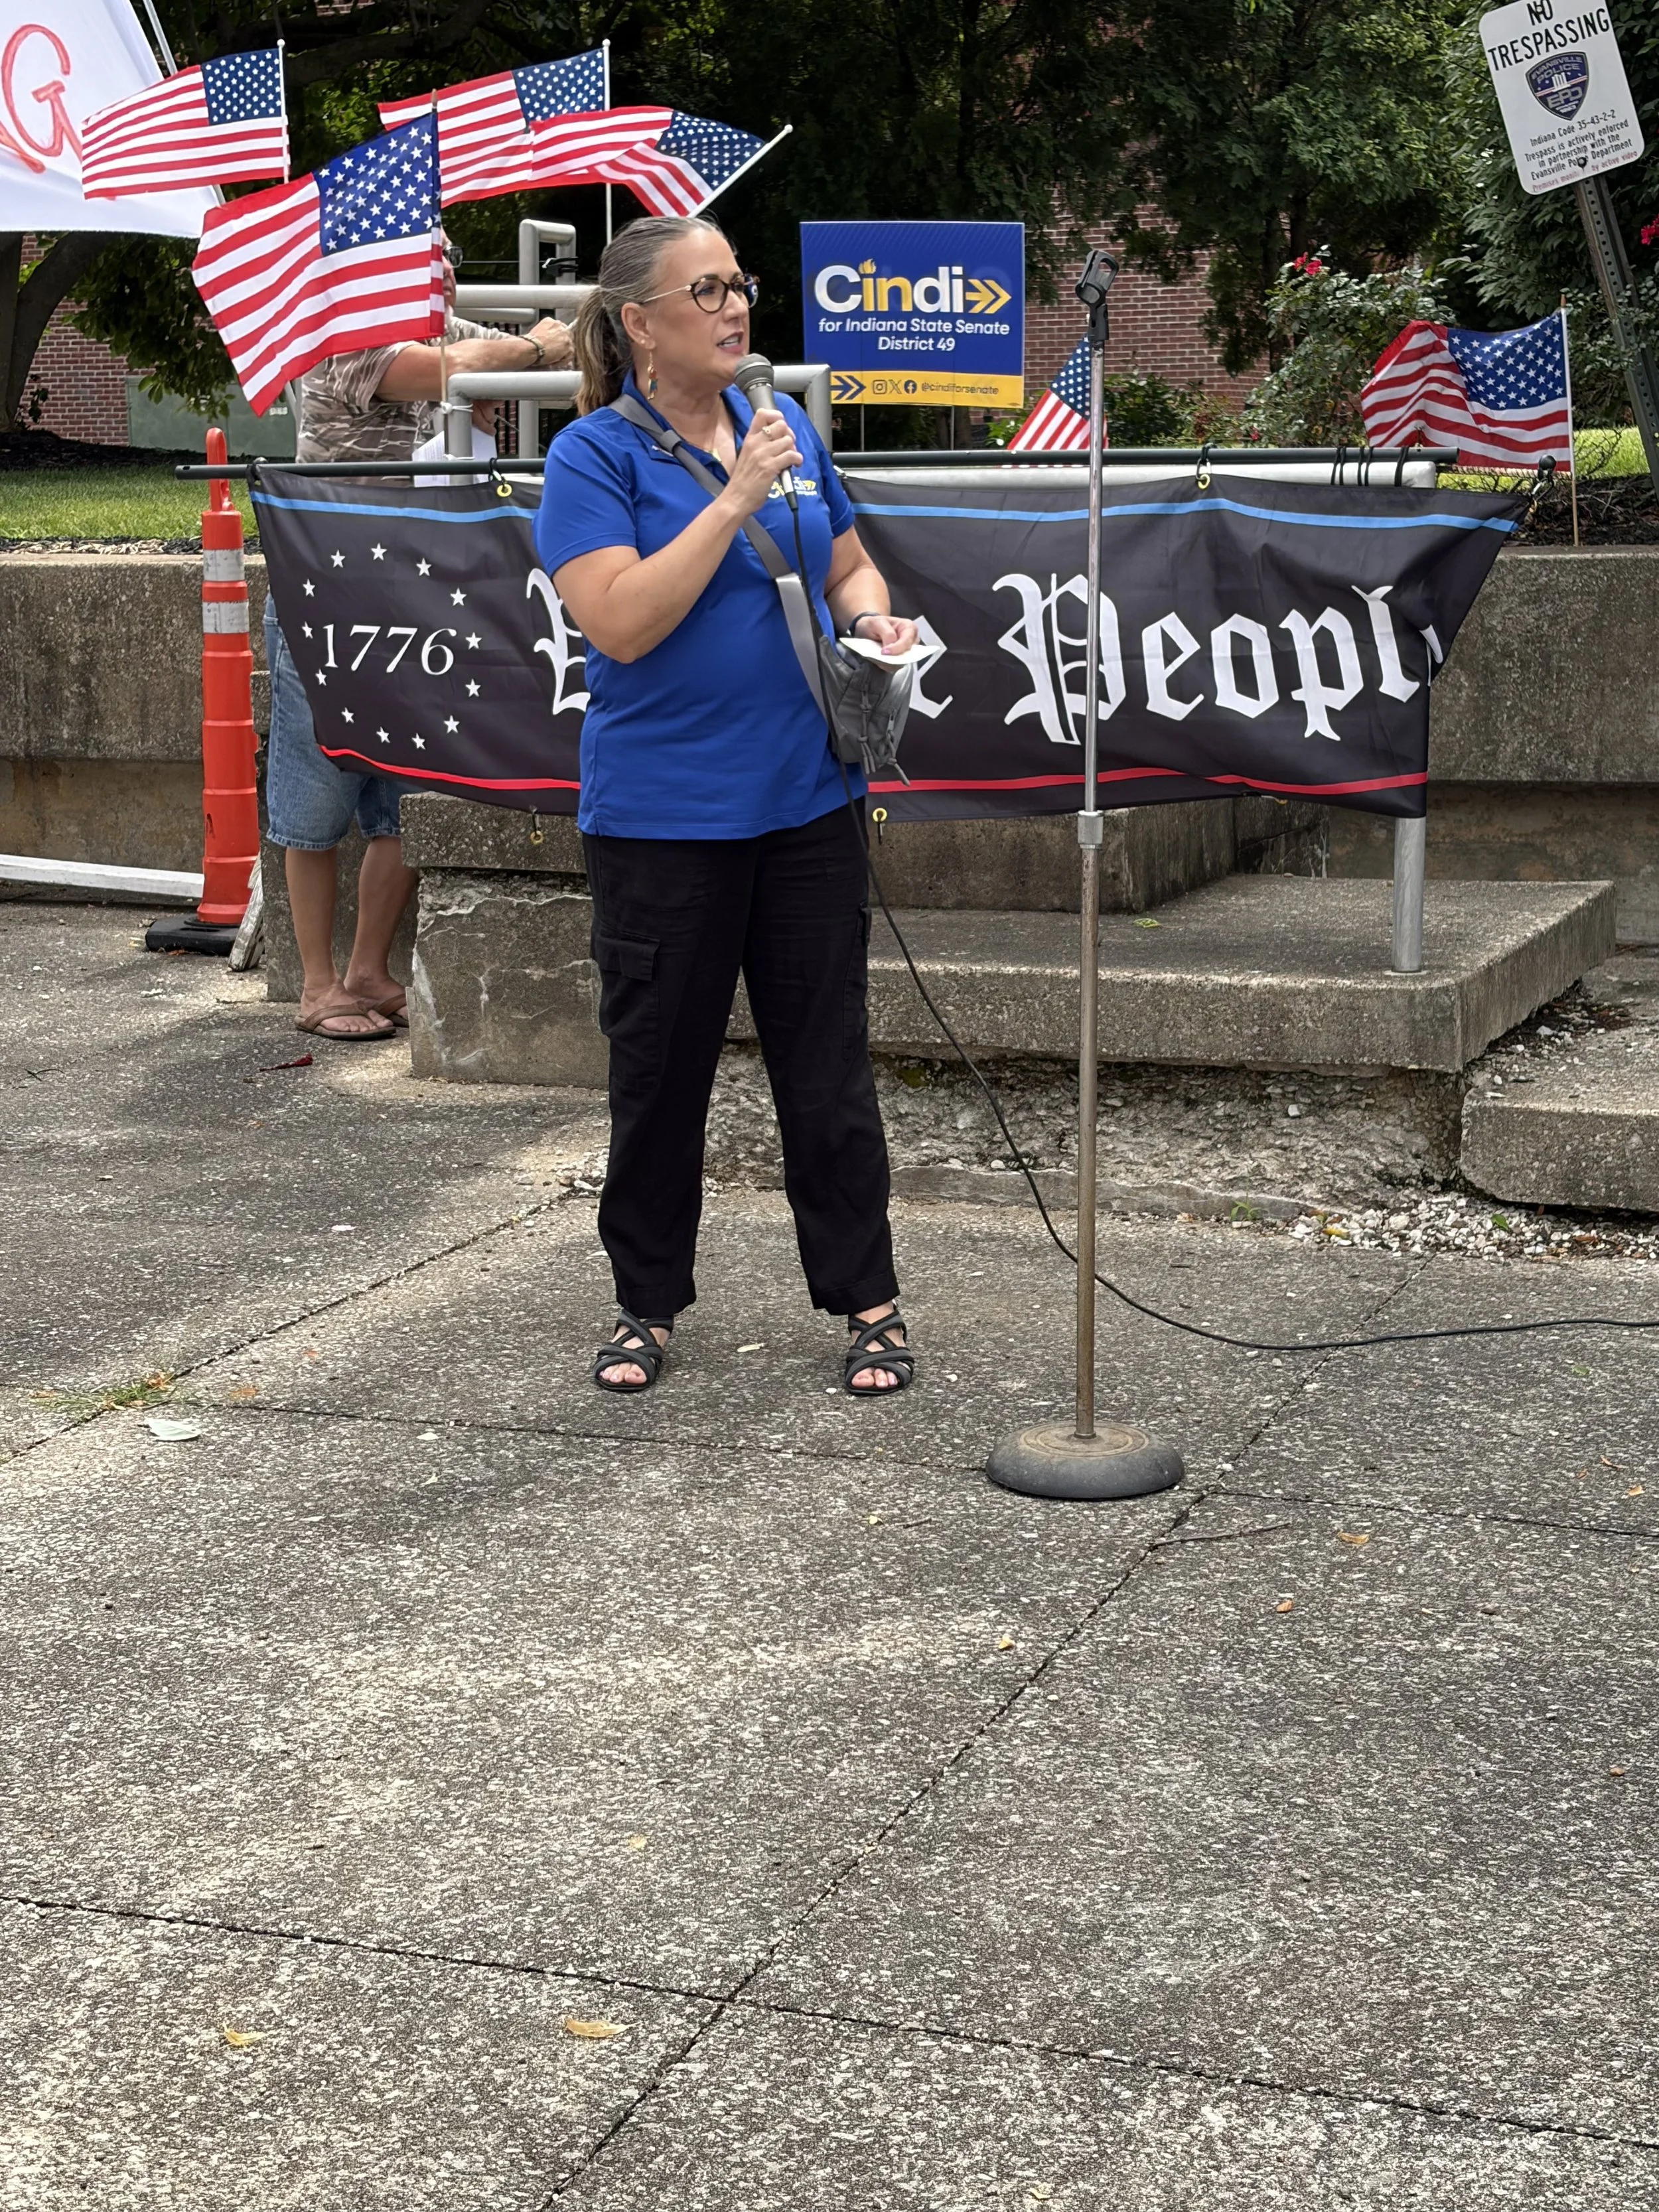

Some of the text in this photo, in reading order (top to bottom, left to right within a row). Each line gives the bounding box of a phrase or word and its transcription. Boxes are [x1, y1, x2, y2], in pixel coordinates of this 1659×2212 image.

[1527, 0, 1553, 26] NO
[1488, 8, 1610, 71] TRESPASSING
[1531, 56, 1583, 79] EVANSVILLE
[1537, 63, 1581, 84] POLICE
[1546, 86, 1583, 108] EPD
[1524, 147, 1555, 162] Trespass
[1568, 132, 1595, 147] actively
[1598, 119, 1629, 136] enforced
[1530, 110, 1616, 147] Indiana Code 35-43-2-2
[1531, 163, 1566, 181] Evansville
[1591, 139, 1632, 160] Department
[1548, 145, 1588, 166] partnership
[1591, 139, 1607, 149] with
[1608, 133, 1620, 143] the
[1621, 151, 1638, 161] video
[814, 259, 964, 313] Cindi
[818, 317, 1010, 336] for Indiana State Senate
[877, 336, 956, 352] District 49
[922, 382, 999, 395] @cindiforsenate
[323, 624, 457, 676] 1776
[992, 573, 1443, 745] Peopl
